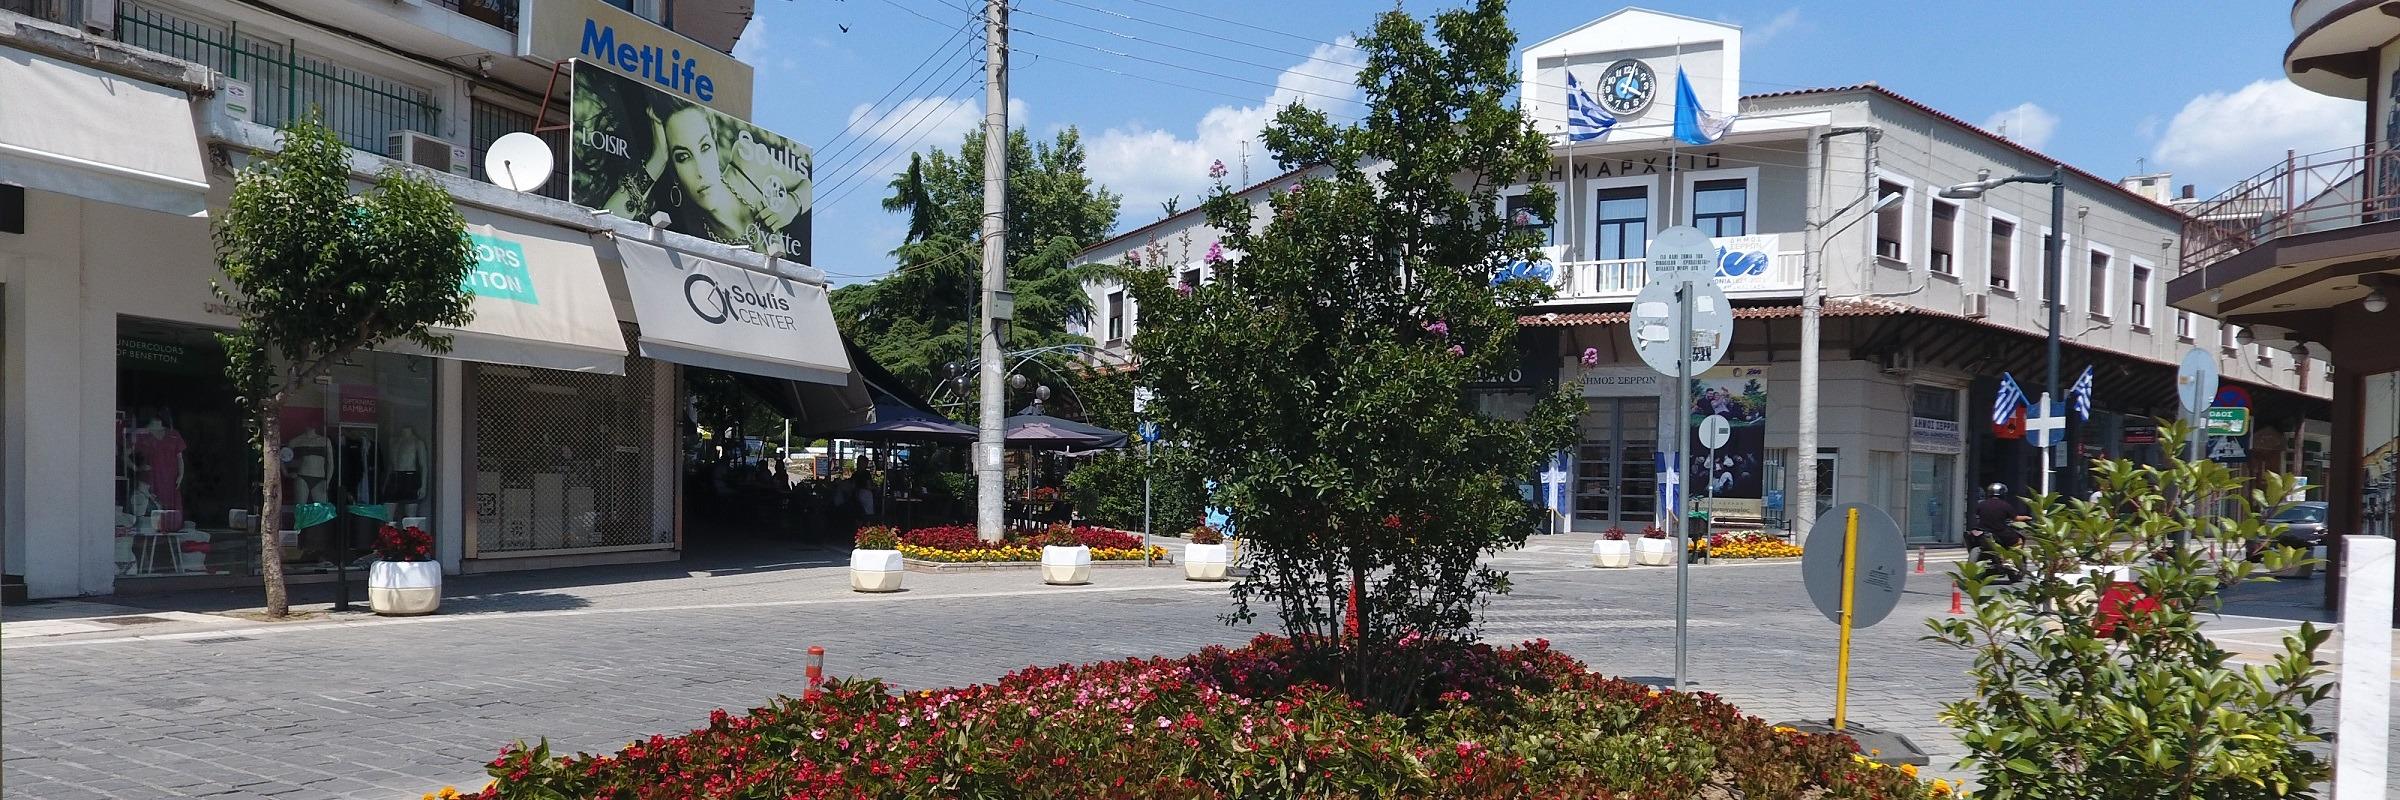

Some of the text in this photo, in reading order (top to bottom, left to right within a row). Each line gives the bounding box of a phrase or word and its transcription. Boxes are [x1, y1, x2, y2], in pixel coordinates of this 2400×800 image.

[580, 17, 714, 102] MetLife
[1608, 76, 1616, 85] 10
[1641, 73, 1647, 81] 2
[1605, 86, 1611, 94] 9
[1644, 82, 1649, 90] 3
[1623, 102, 1630, 110] 6
[1633, 98, 1639, 106] 5
[582, 127, 631, 160] LOISIR
[738, 130, 809, 180] Soulis
[731, 285, 790, 311] Soulis
[739, 308, 797, 331] CENTER
[116, 338, 184, 355] UNDERCOLORS
[130, 350, 177, 364] BENETTON
[1582, 376, 1657, 385] ΔΗΜΟΣ ΣΕΡΡΩΝ
